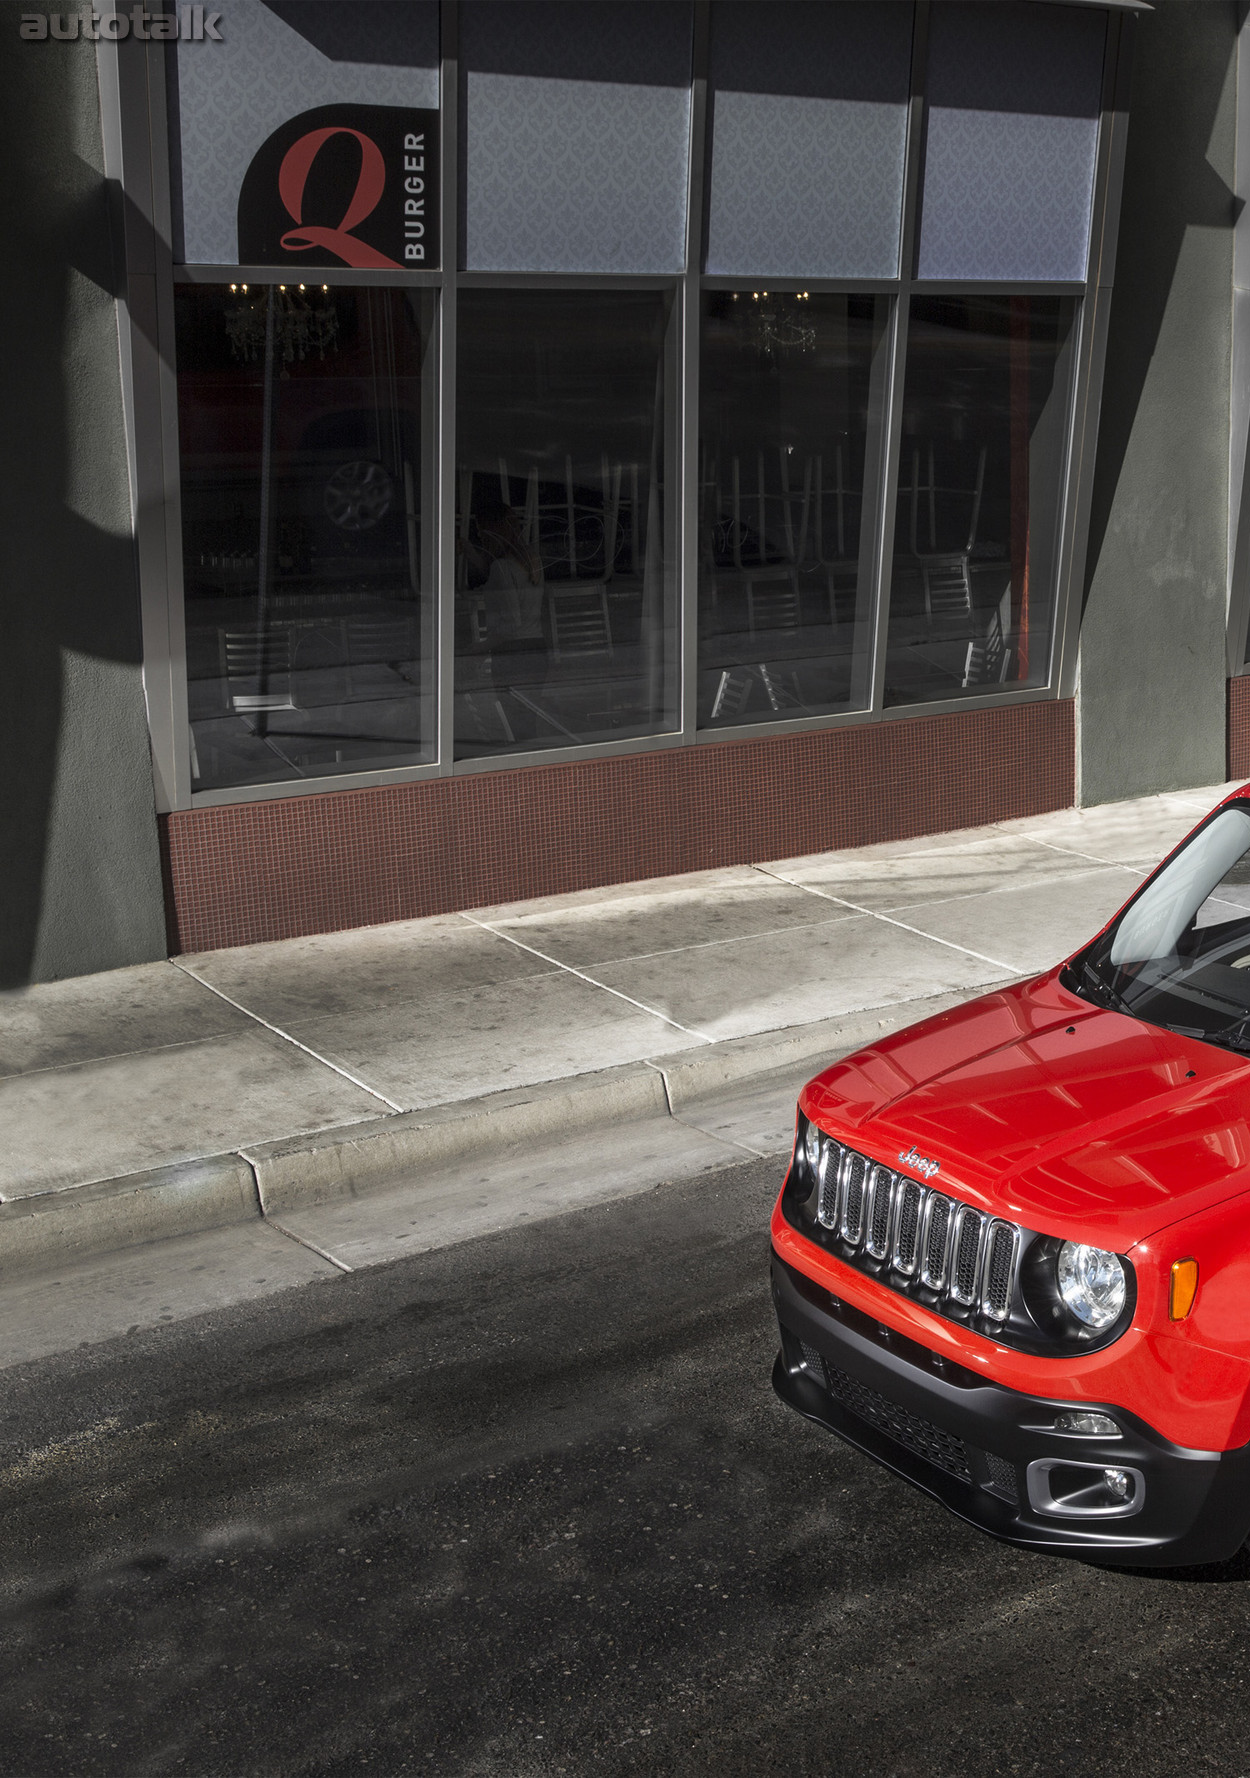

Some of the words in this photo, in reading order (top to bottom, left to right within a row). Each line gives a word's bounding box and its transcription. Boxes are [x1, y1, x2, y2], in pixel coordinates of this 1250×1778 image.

[278, 126, 406, 268] Q
[404, 133, 425, 260] BURGER
[898, 1145, 941, 1179] Jeep
